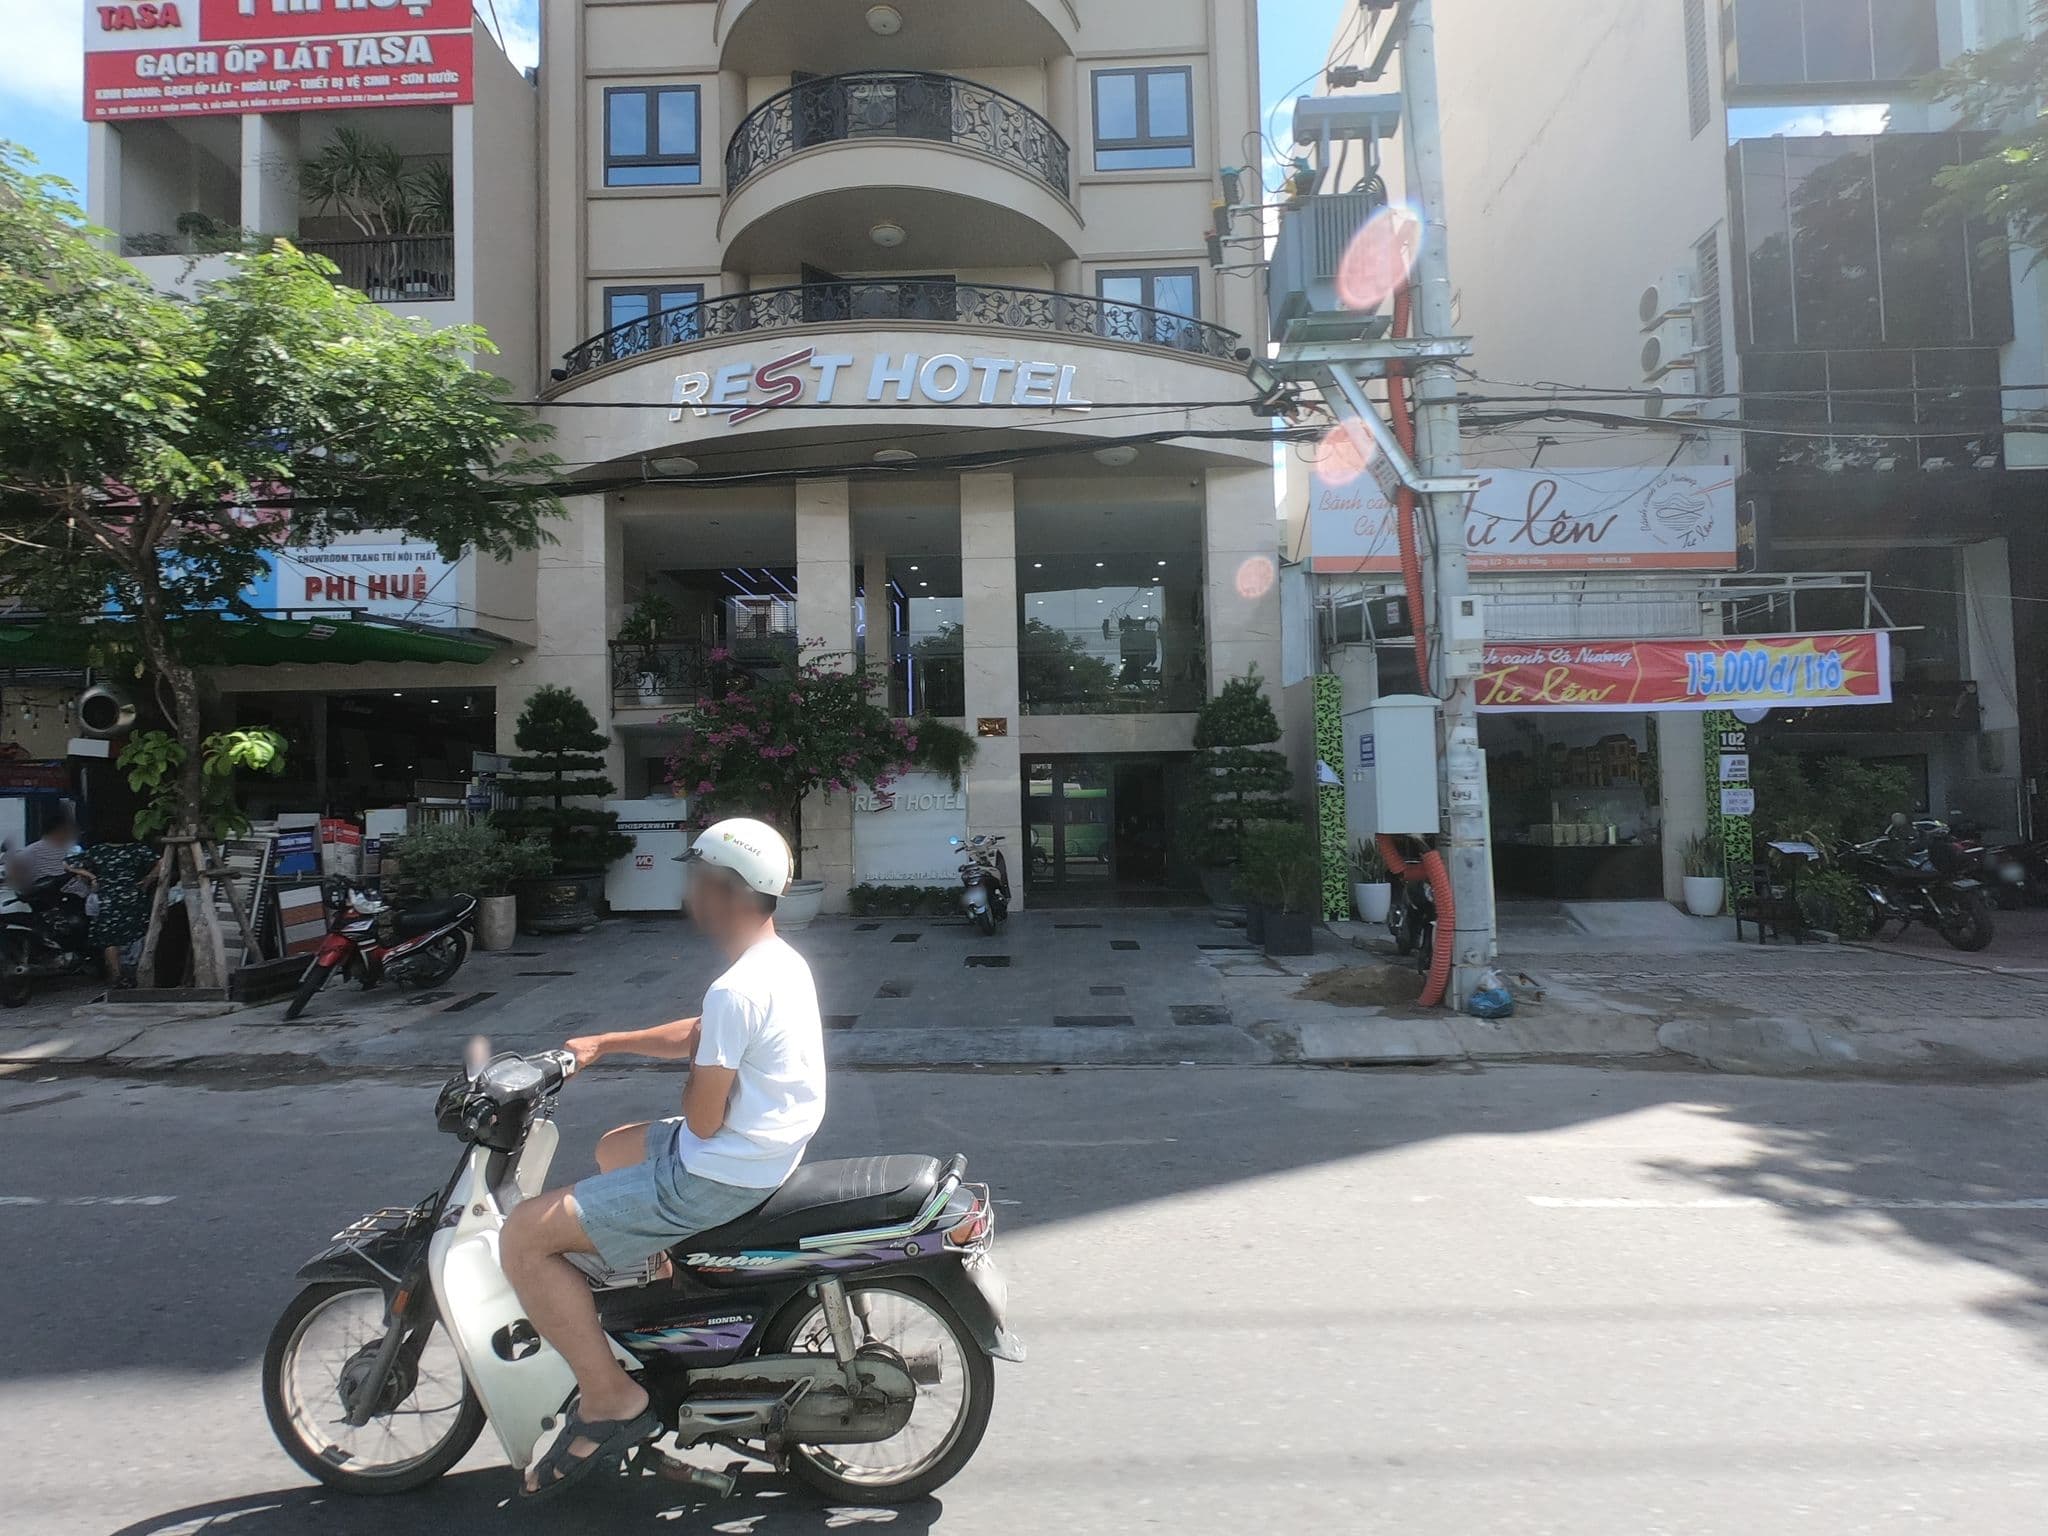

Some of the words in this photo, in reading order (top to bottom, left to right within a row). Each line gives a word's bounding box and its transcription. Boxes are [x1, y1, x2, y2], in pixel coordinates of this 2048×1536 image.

[97, 3, 181, 31] TASA
[135, 51, 218, 82] GẠCH
[273, 42, 333, 71] LÁT
[337, 35, 434, 68] TASA
[668, 345, 853, 425] REST
[867, 353, 1092, 412] HOTEL
[297, 553, 349, 564] SHOWROOM
[351, 553, 379, 562] TRANG
[381, 551, 395, 562] TRÍ
[305, 575, 356, 601] PHI
[1501, 649, 1546, 664] canh
[1548, 648, 1572, 664] Cá
[1575, 647, 1633, 667] Nướng
[1720, 732, 1745, 746] 102
[906, 793, 966, 811] HOTEL
[617, 822, 676, 830] WHISPERWATT
[686, 1252, 782, 1267] Dream
[707, 1315, 743, 1325] HONDA
